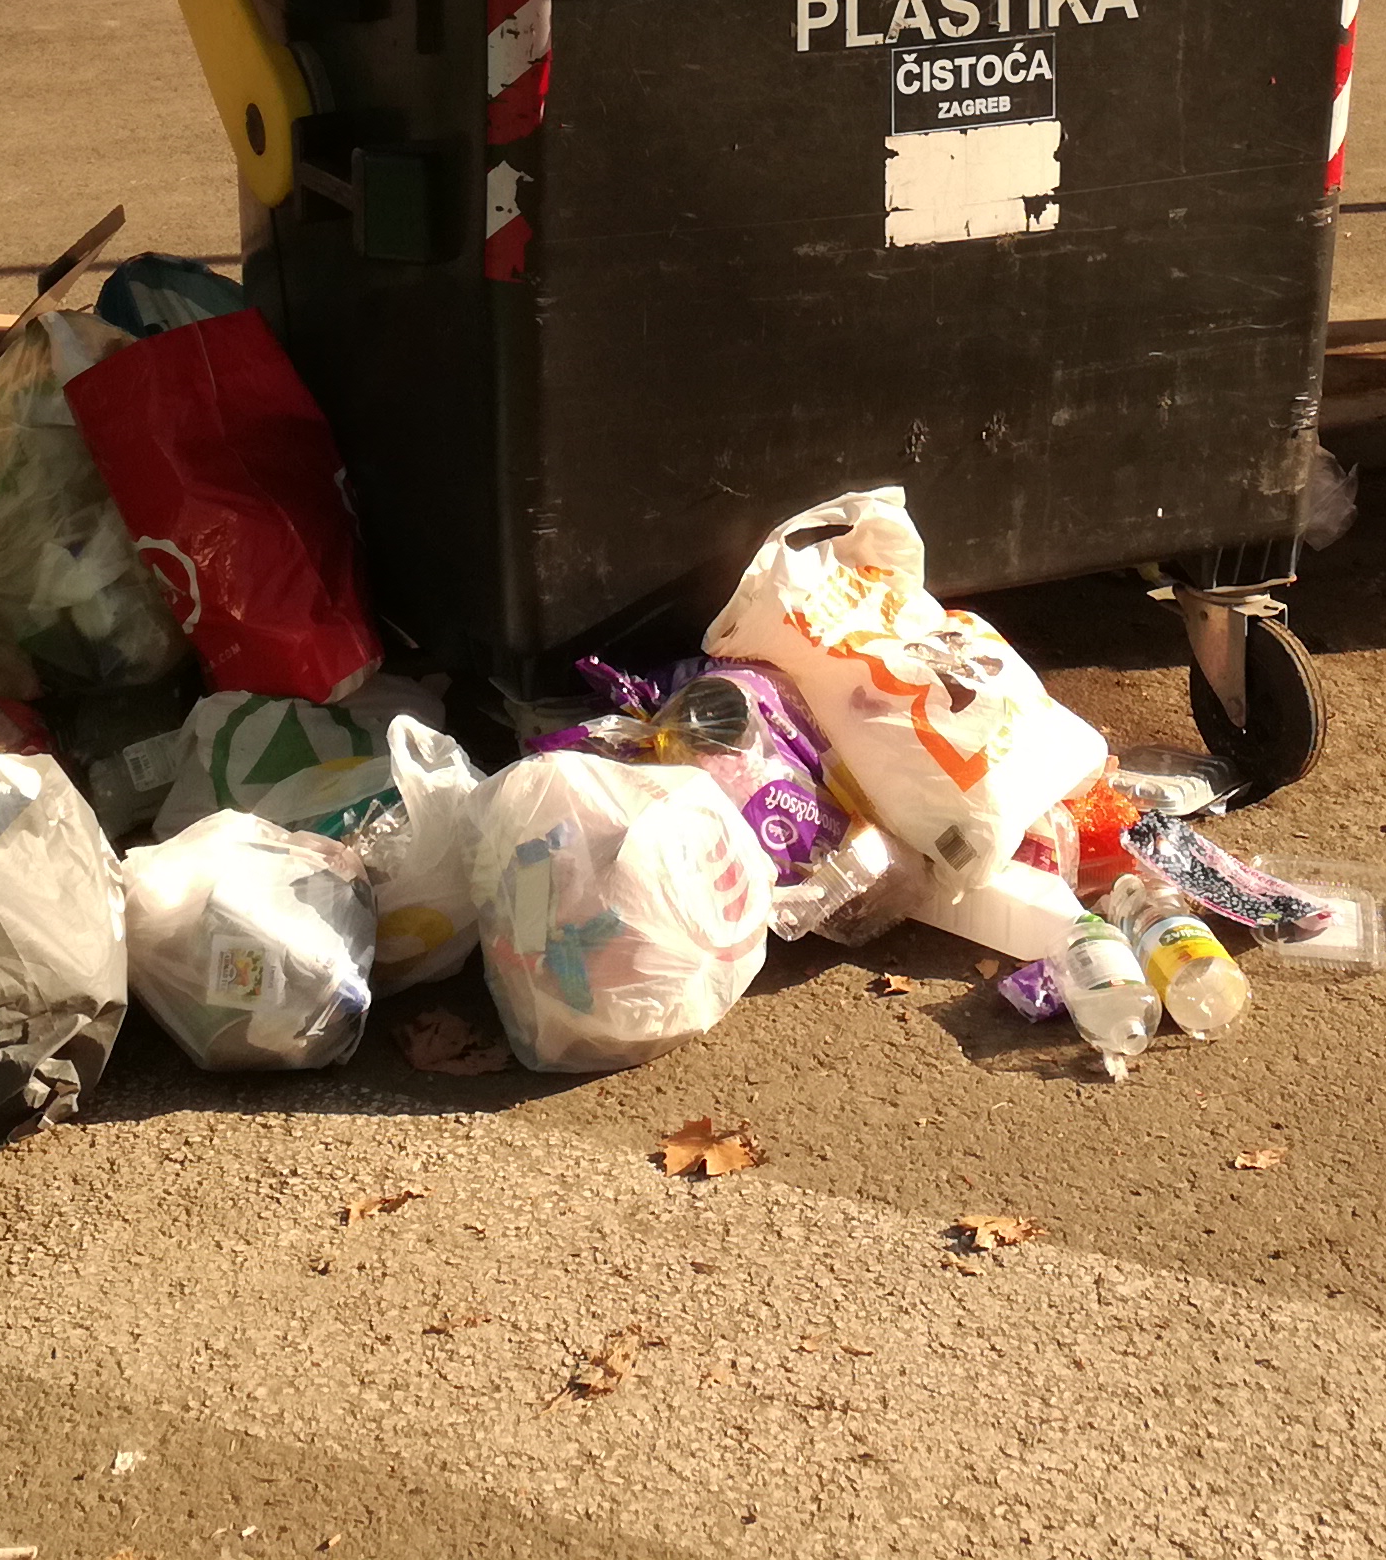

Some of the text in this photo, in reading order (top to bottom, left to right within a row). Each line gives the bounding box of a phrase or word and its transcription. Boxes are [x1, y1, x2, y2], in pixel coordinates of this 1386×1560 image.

[896, 42, 1053, 96] ČISTOĆA
[937, 95, 1012, 119] ZAGREB
[764, 786, 842, 837] strong&soft
